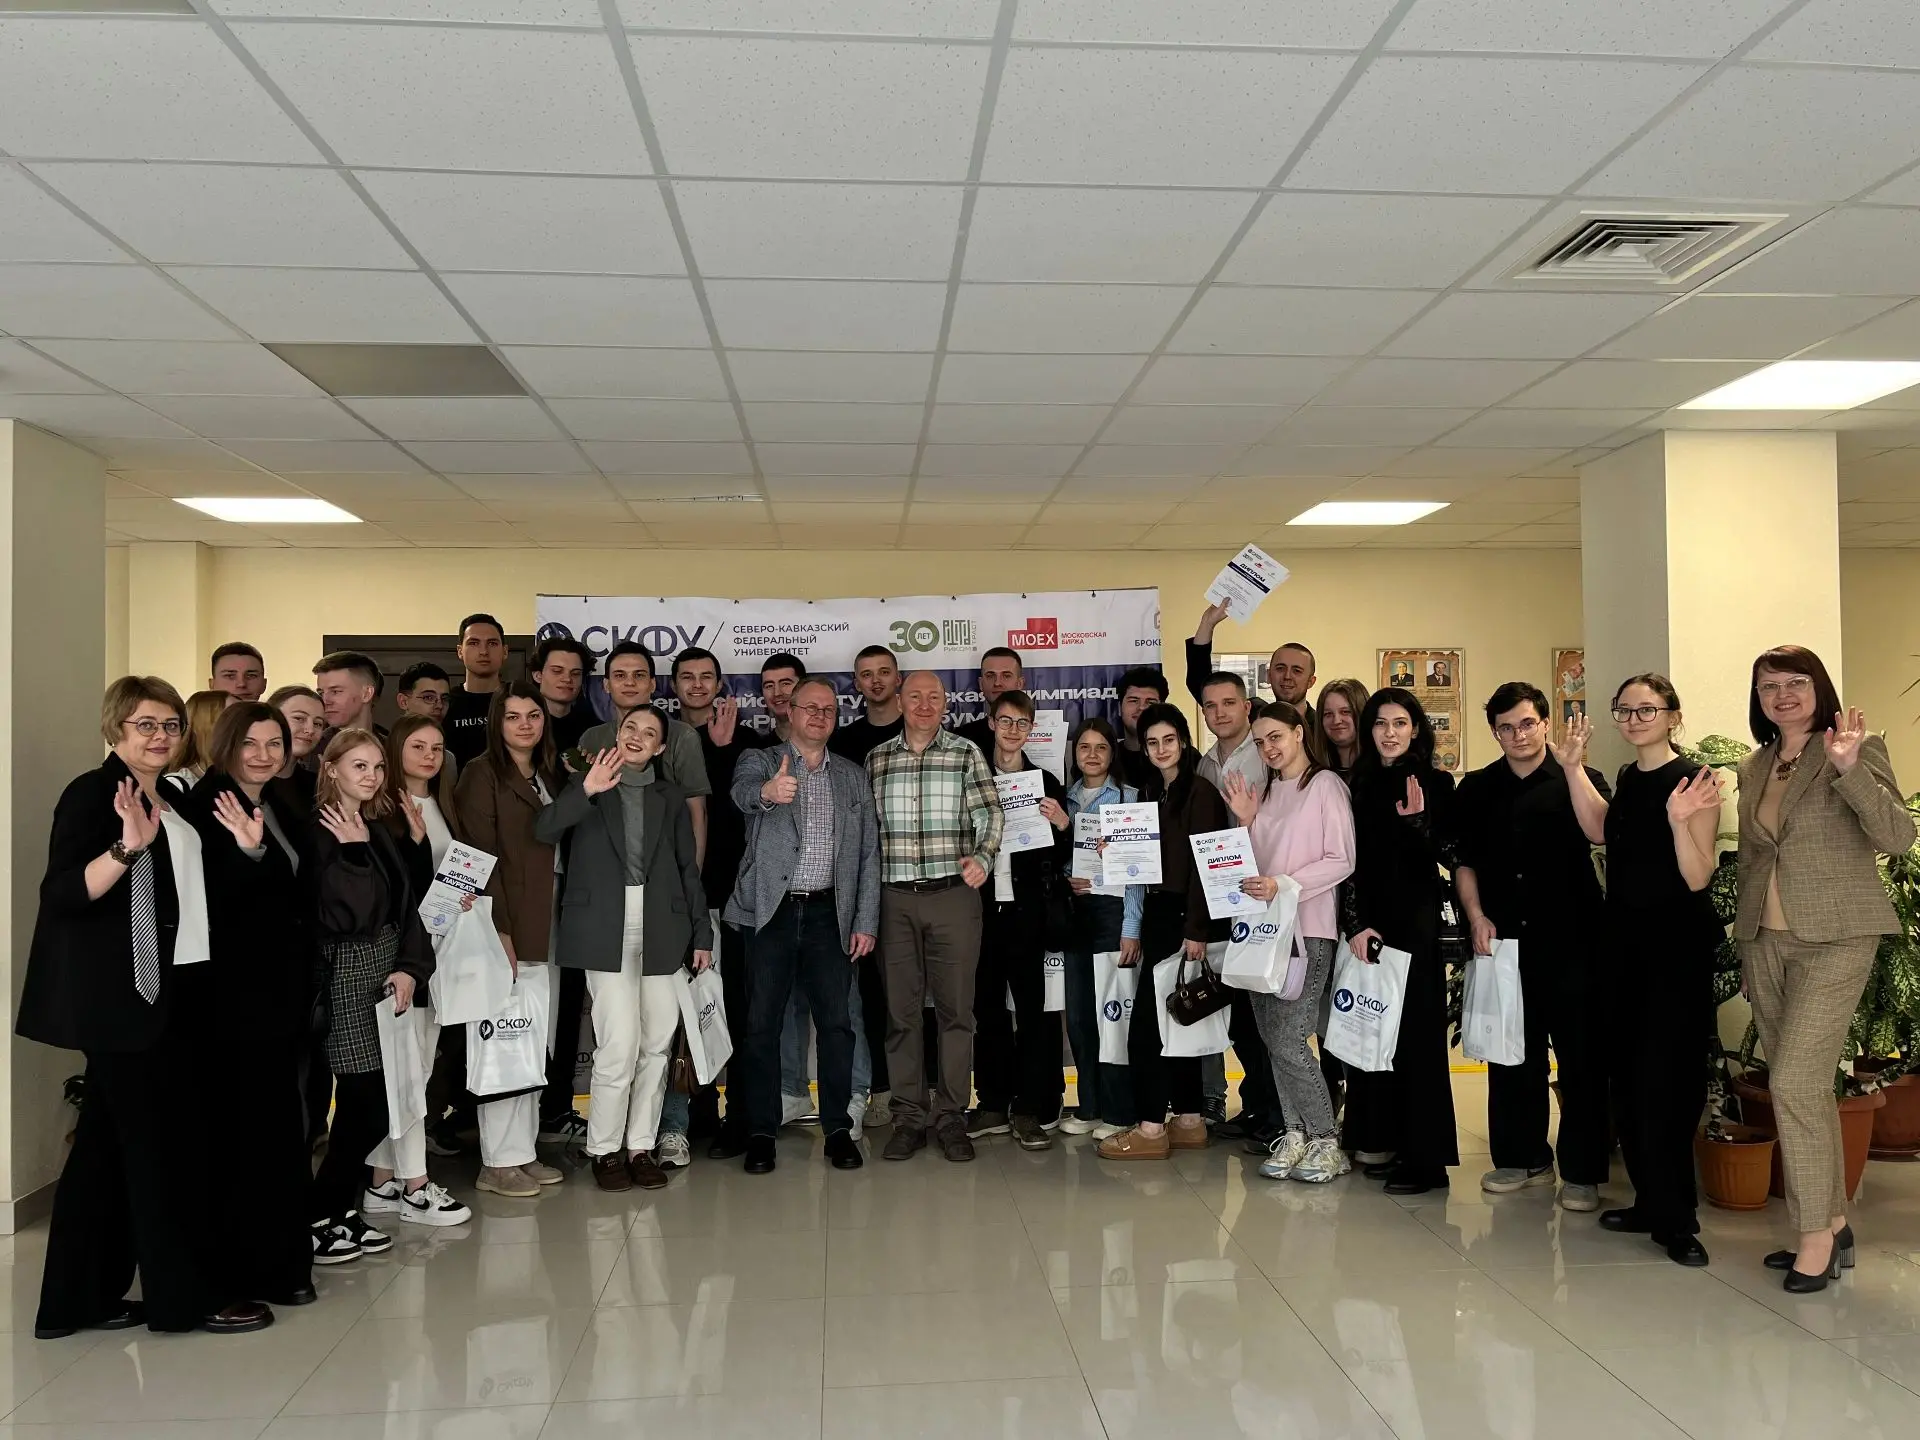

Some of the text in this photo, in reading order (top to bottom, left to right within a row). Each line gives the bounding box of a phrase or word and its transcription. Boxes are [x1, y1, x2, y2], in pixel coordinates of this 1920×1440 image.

[733, 622, 850, 634] СЕВЕРО-КАВКАЗСКИЙ
[581, 625, 706, 657] СКФУ
[733, 634, 817, 646] ФЕДЕРАЛЬНЫЙ
[888, 620, 940, 652] 30
[917, 632, 931, 640] ЛЕТ
[1011, 633, 1056, 647] MOEX
[1061, 631, 1107, 639] МОСКОВСКАЯ
[734, 647, 810, 657] УНИВЕРСИТЕТ
[1023, 687, 1119, 701] импиад
[453, 716, 488, 728] TRUSS
[1208, 854, 1242, 864] ДИПЛОМ
[449, 870, 477, 885] ДИПЛОМ
[443, 877, 476, 893] ЛАУРЕАТА
[1356, 994, 1389, 1014] СКФУ
[496, 1017, 533, 1030] СКФУ
